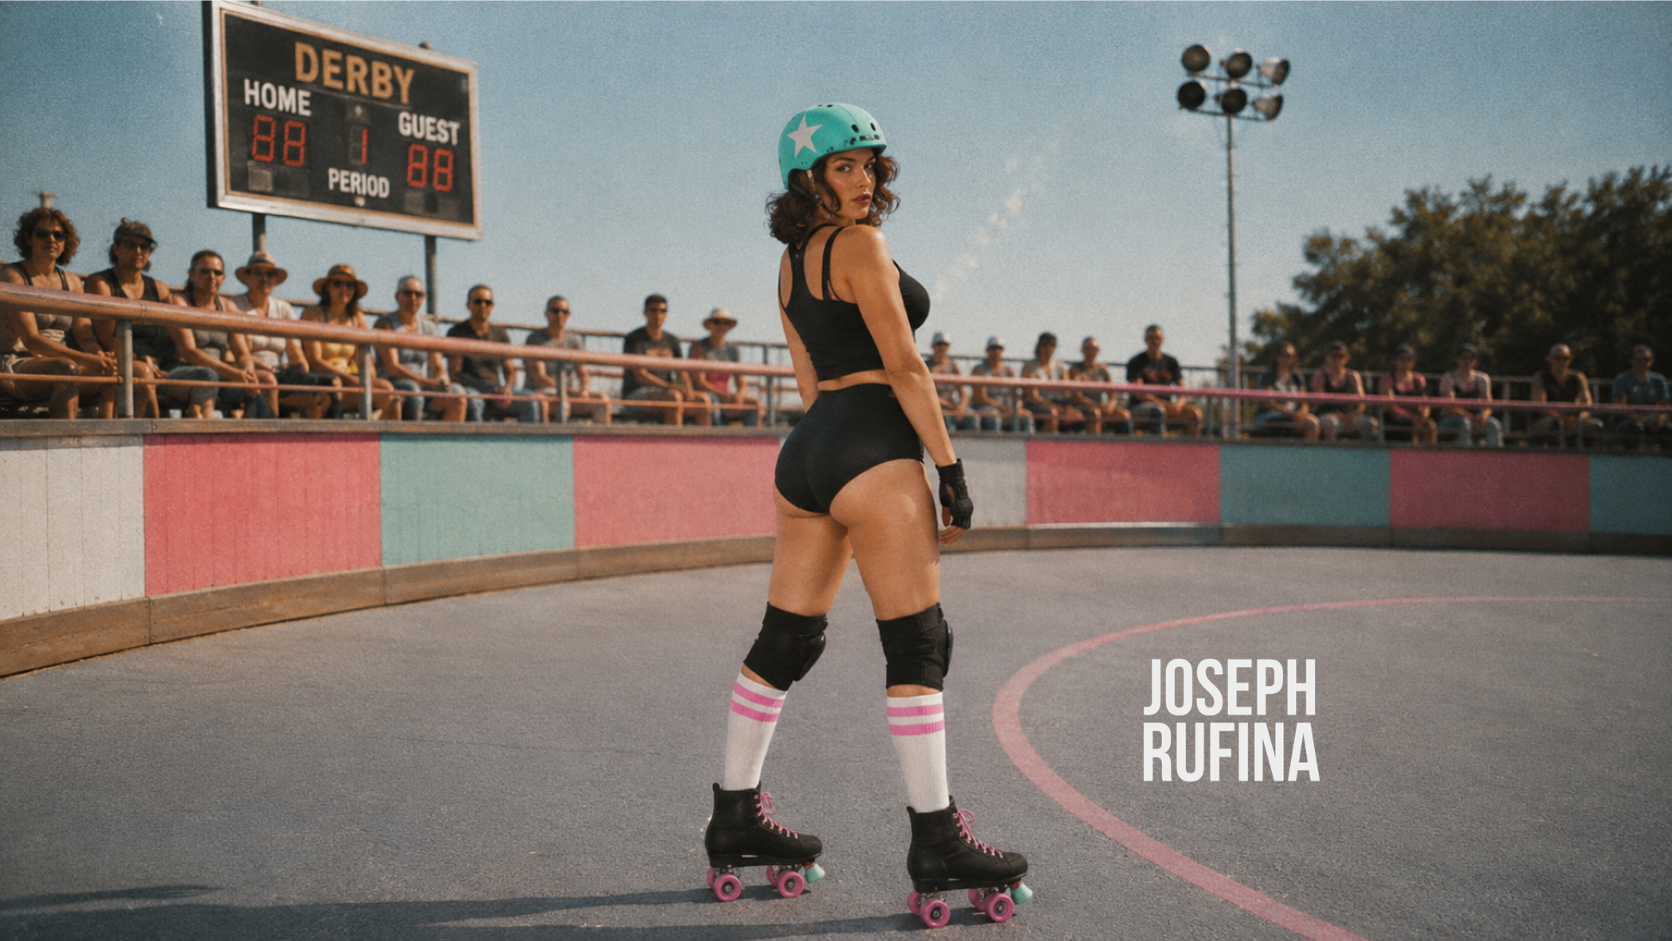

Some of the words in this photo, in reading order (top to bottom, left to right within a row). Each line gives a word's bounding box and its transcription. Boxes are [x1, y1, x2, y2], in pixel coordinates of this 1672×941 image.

[295, 42, 414, 104] DERBY
[244, 78, 311, 116] HOME
[252, 114, 306, 167] 88
[361, 129, 368, 164] 1
[398, 112, 460, 145] GUEST
[328, 168, 390, 198] PERIOD
[407, 144, 453, 191] 88
